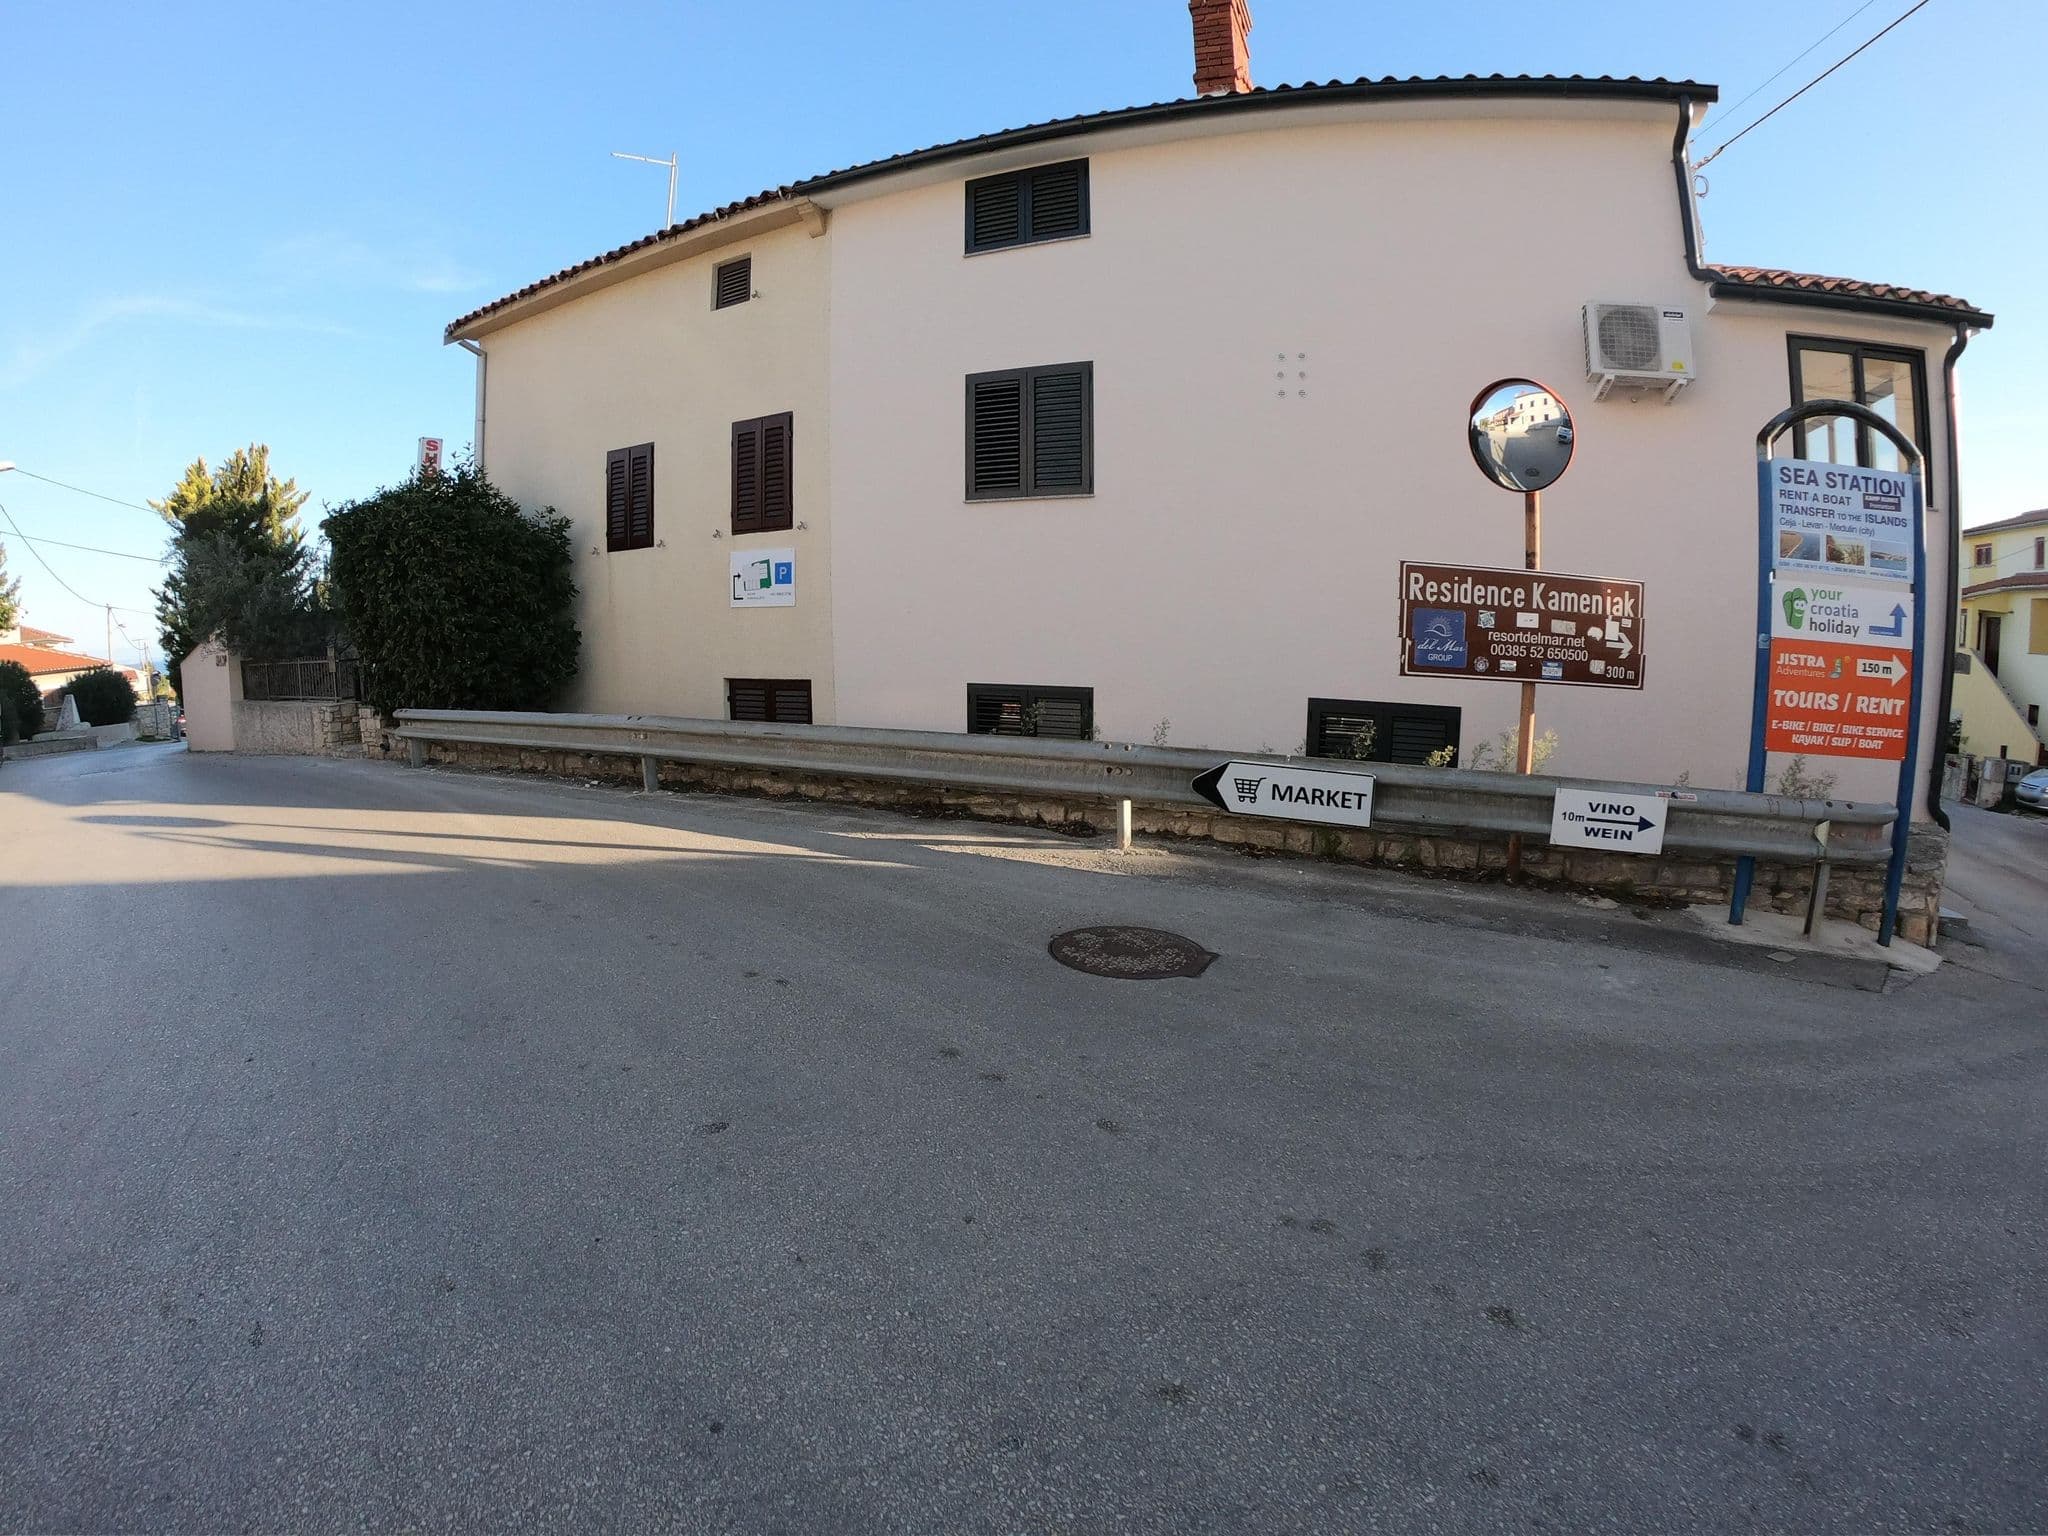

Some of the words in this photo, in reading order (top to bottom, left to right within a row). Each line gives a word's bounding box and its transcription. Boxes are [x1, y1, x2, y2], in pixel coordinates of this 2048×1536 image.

[1779, 466, 1820, 487] SEA
[1825, 471, 1906, 498] STATION
[1779, 489, 1809, 501] RENT
[1812, 493, 1820, 502] A
[1823, 493, 1852, 506] BOAT
[1779, 503, 1835, 519] TRANSFER
[1837, 512, 1847, 520] TO
[1848, 513, 1862, 522] THE
[1865, 513, 1908, 528] ISLANDS
[1779, 517, 1797, 529] Ceja
[1801, 519, 1824, 529] Levan
[1829, 522, 1857, 534] Medulin
[1858, 525, 1875, 537] (city)
[779, 566, 787, 580] P
[1409, 572, 1525, 608] Residence
[1811, 588, 1843, 601] your
[1810, 604, 1859, 619] croatia
[1809, 617, 1860, 638] holiday
[1417, 638, 1438, 650] del
[1437, 639, 1464, 652] Mar
[1488, 631, 1585, 648] resortdelmar.net
[1427, 653, 1453, 662] GROUP
[1490, 643, 1527, 657] 00385
[1529, 646, 1544, 658] 52
[1547, 648, 1589, 661] 650500
[1776, 653, 1826, 668] JISTRA
[1606, 665, 1625, 678] 300
[1626, 670, 1635, 679] m
[1775, 666, 1825, 678] Adventures
[1861, 662, 1880, 674] 150
[1882, 665, 1892, 675] m
[1773, 689, 1840, 711] TOURS
[1856, 696, 1905, 716] RENT
[1771, 720, 1805, 731] E-BIKE
[1812, 723, 1835, 734] BIKE
[1842, 726, 1865, 736] BIKE
[1866, 727, 1904, 738] SERVICE
[1792, 734, 1824, 746] KAYAK
[1831, 737, 1852, 747] SUP
[1859, 739, 1884, 750] BOAT
[1271, 783, 1367, 810] MARKET
[1561, 811, 1585, 822] 10m
[1588, 802, 1635, 816] VINO
[1584, 826, 1633, 840] WEIN
